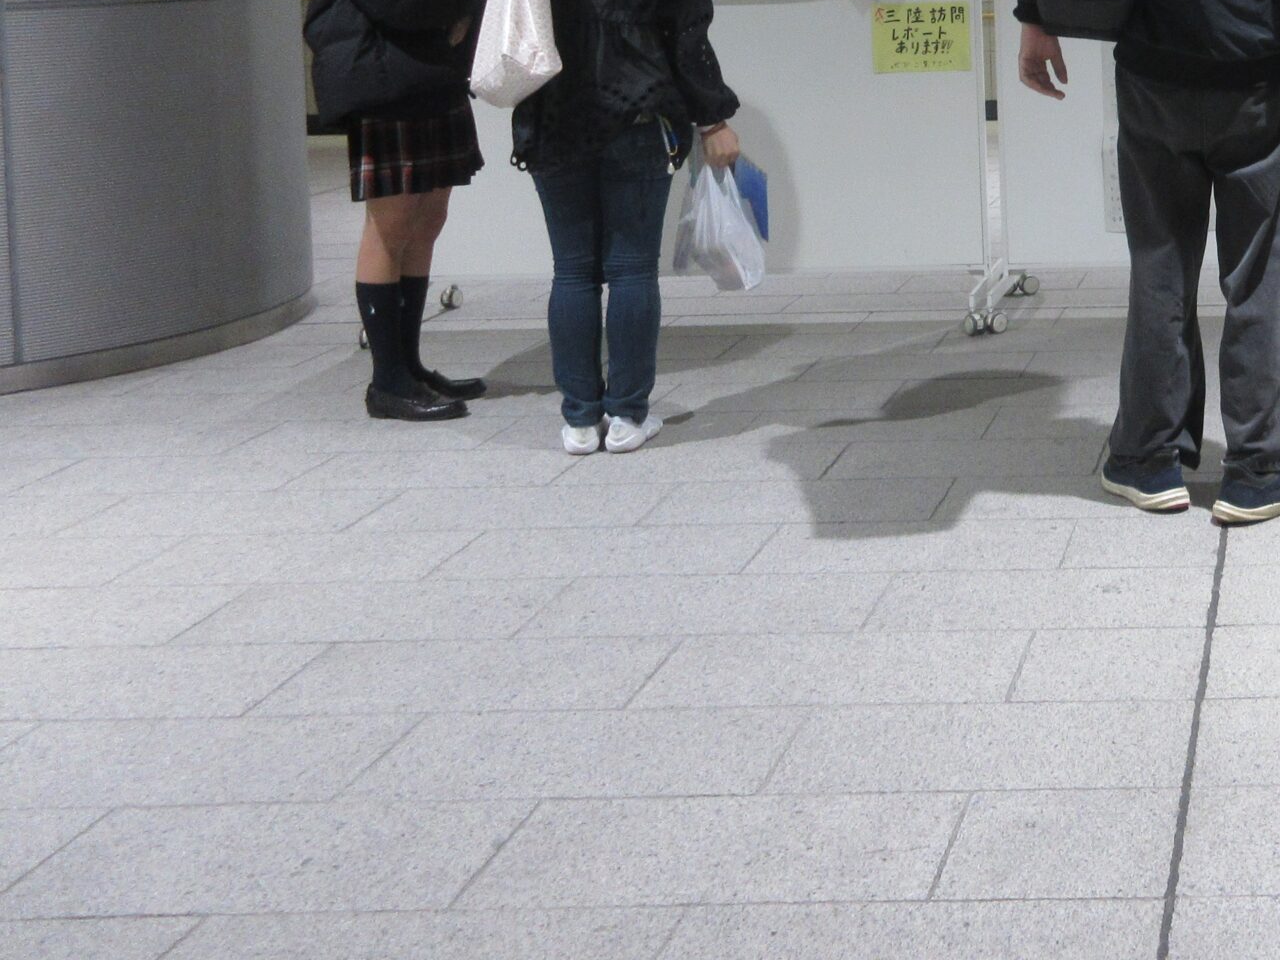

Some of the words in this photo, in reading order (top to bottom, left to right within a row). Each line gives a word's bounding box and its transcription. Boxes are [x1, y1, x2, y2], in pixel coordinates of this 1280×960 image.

[884, 6, 965, 24] 三陸訪問
[892, 26, 947, 41] レポート
